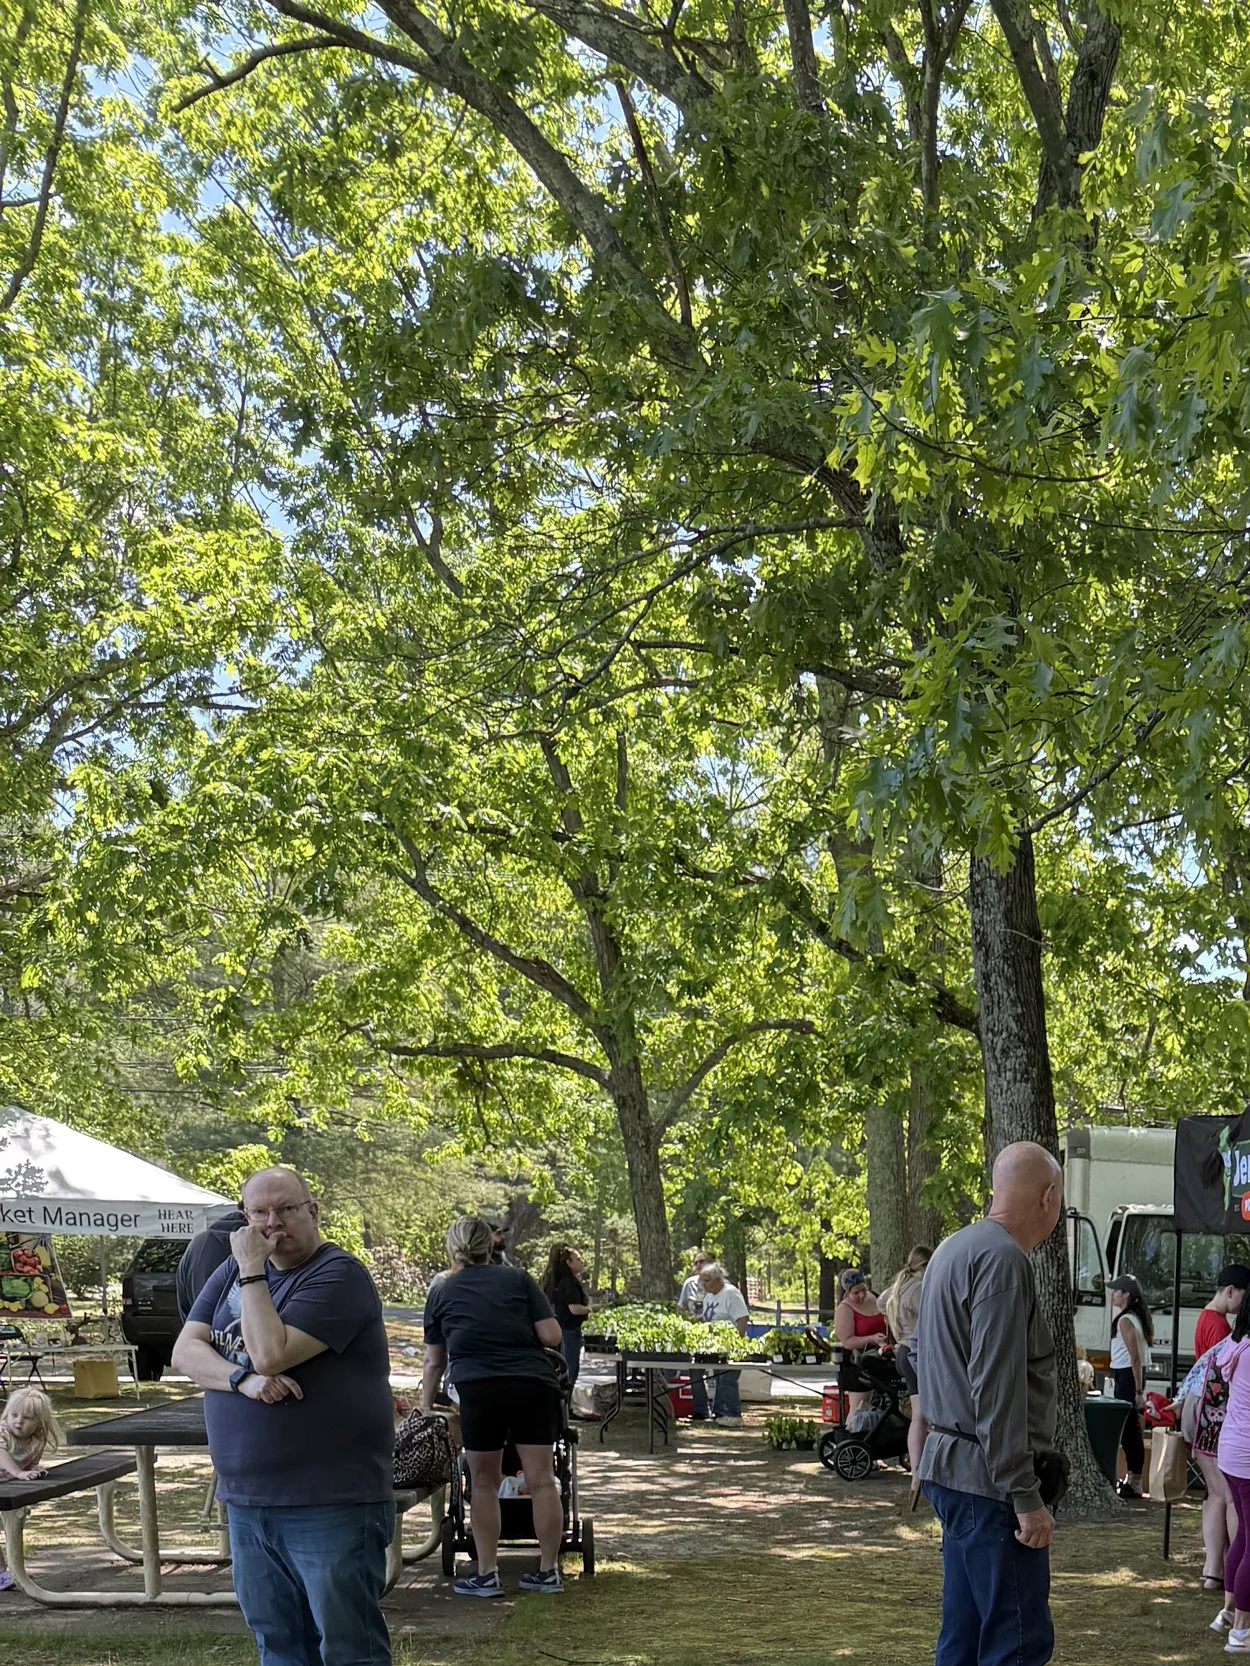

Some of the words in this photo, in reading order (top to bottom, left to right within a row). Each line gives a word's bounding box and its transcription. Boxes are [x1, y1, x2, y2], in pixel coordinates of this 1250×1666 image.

[43, 1206, 141, 1232] Manager
[158, 1208, 194, 1221] HEAR
[161, 1222, 194, 1234] HERE
